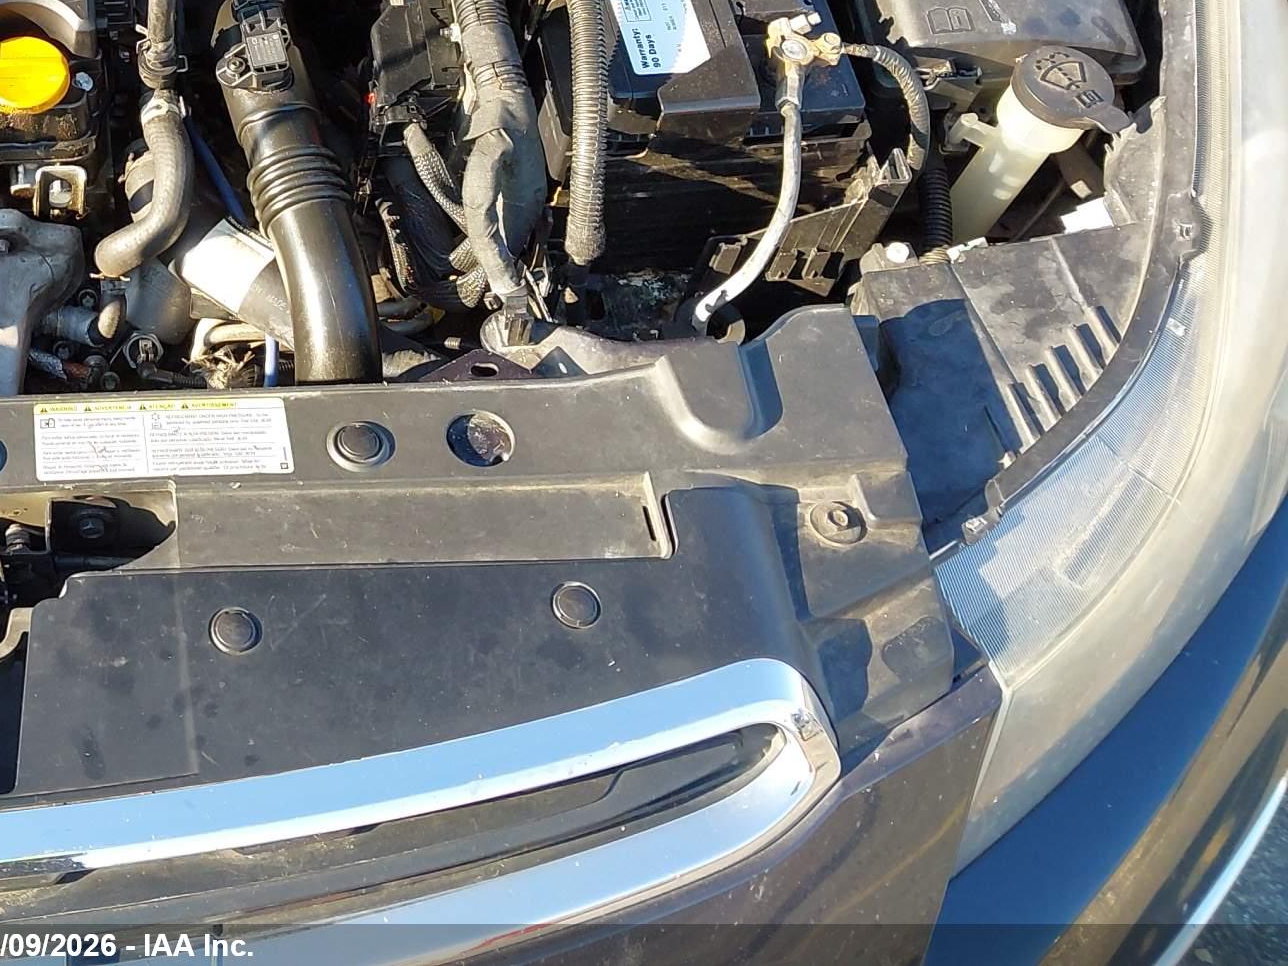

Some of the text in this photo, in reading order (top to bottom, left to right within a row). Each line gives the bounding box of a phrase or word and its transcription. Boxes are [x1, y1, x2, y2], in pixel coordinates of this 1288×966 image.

[631, 28, 650, 69] Warranty:
[645, 34, 661, 68] 90 Days
